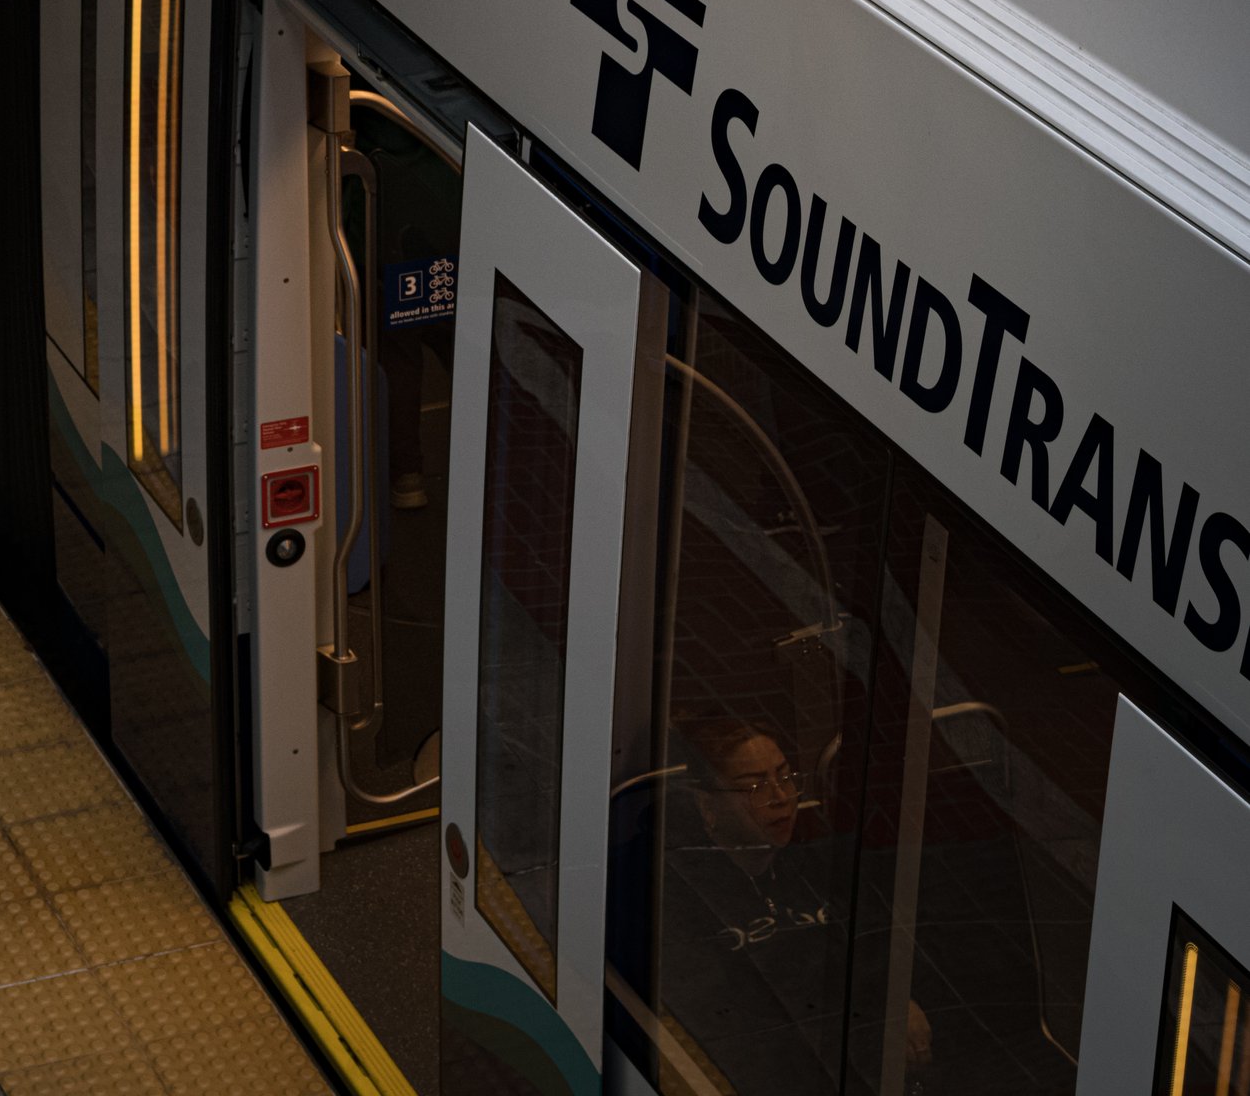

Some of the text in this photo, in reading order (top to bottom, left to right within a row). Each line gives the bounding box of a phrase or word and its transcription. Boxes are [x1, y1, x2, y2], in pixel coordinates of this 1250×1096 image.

[404, 275, 418, 296] 3
[390, 307, 420, 320] allowed
[422, 306, 430, 314] in
[431, 304, 445, 312] this
